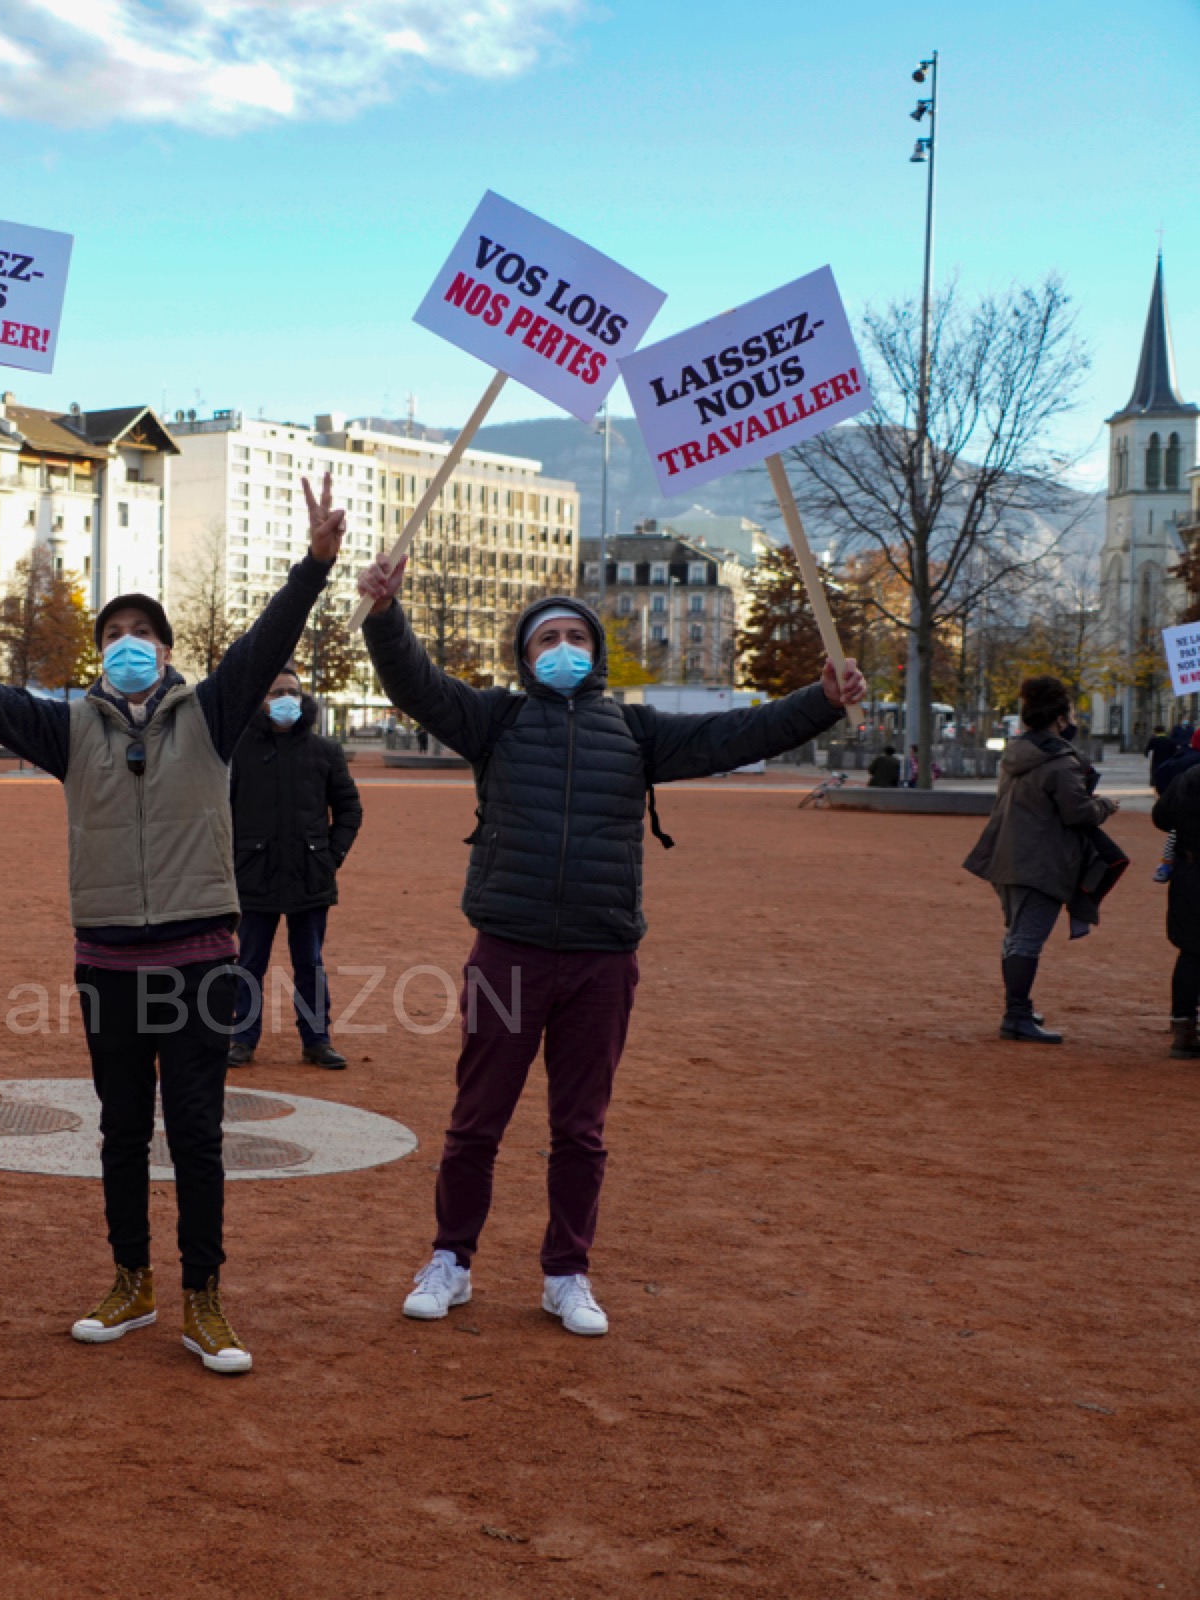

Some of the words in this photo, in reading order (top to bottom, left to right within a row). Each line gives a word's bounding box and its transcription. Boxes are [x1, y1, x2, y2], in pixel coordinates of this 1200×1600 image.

[443, 271, 511, 326] NOS
[505, 305, 608, 385] PERTES
[475, 235, 549, 297] VOS
[545, 278, 628, 346] LOIS
[649, 311, 825, 406] LAISSEZ-
[694, 355, 805, 425] NOUS
[657, 367, 861, 476] TRAVAILLER!
